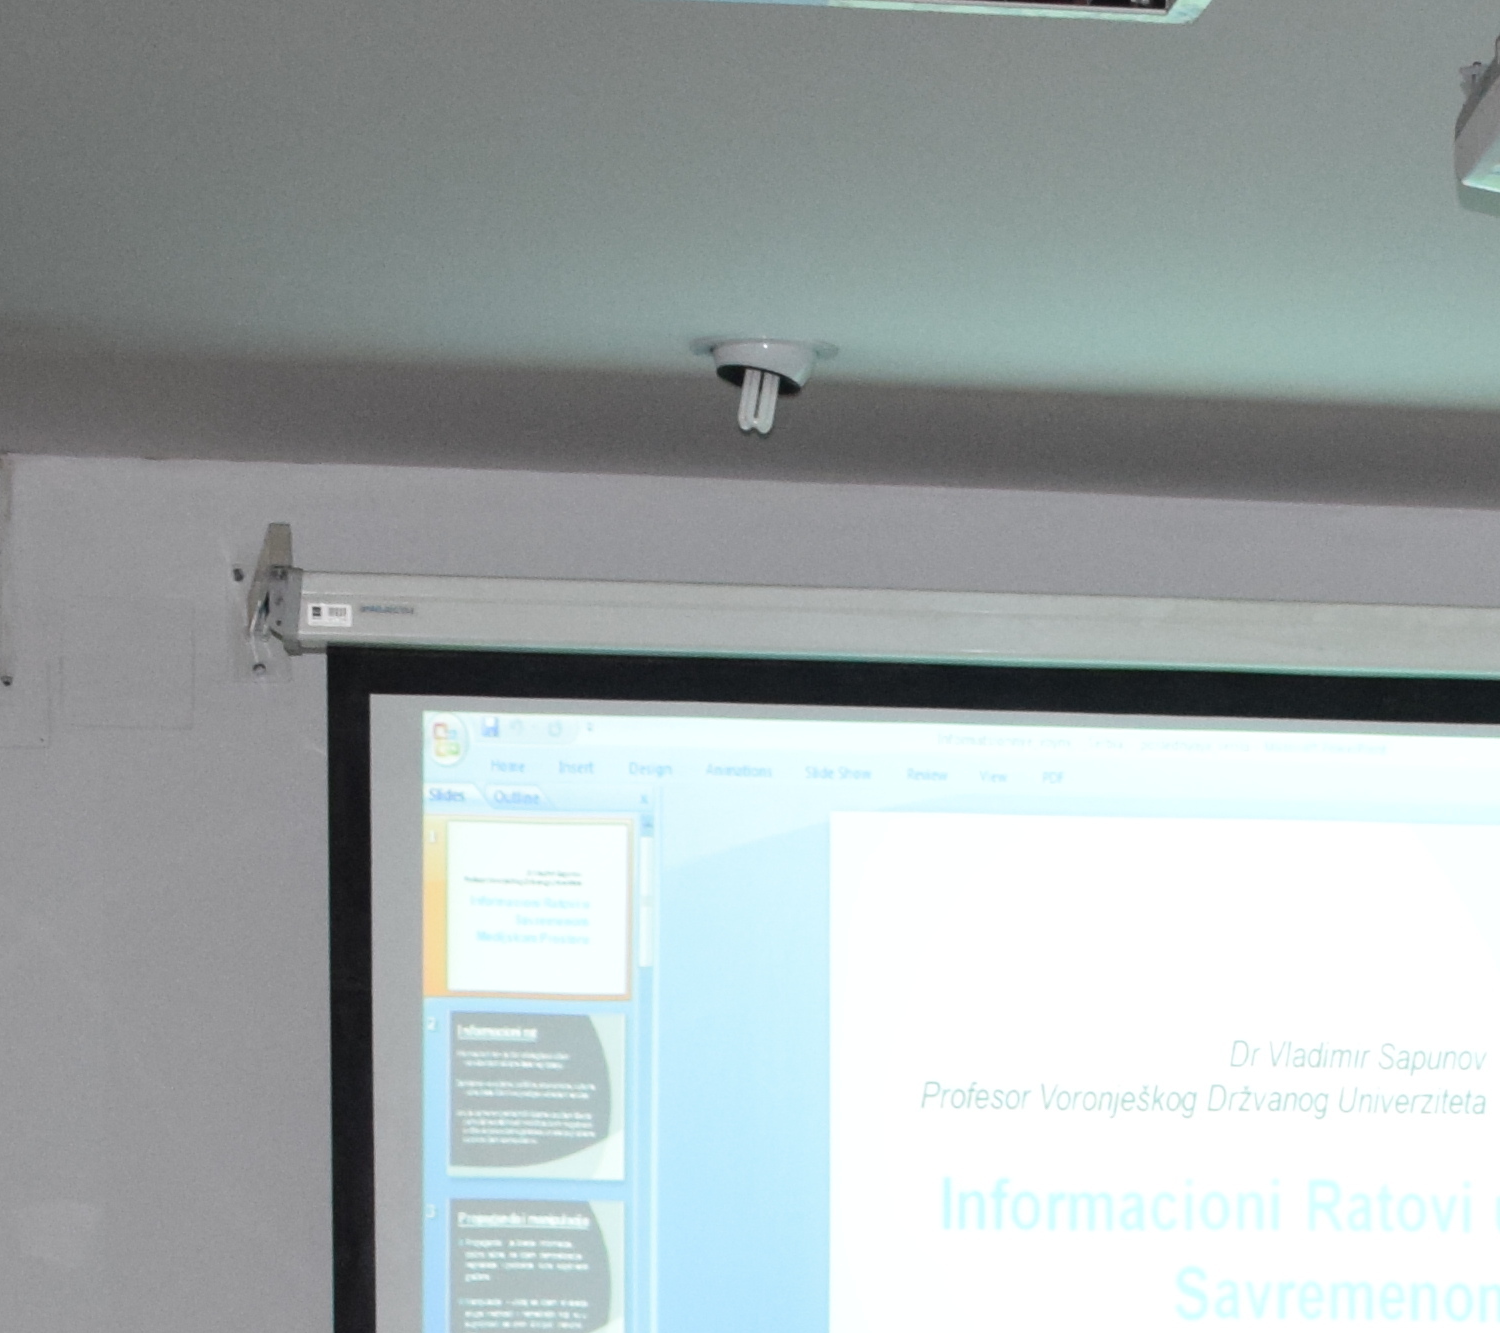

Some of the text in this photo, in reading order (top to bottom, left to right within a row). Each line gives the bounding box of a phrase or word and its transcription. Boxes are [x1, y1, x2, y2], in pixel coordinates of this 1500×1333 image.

[491, 759, 526, 774] Home
[558, 760, 594, 774] Insert
[629, 761, 673, 778] Design
[706, 763, 772, 778] Animations
[805, 764, 872, 780] Slide Show
[906, 767, 948, 782] Review
[978, 769, 1008, 784] View
[1042, 771, 1064, 785] PDF
[429, 787, 465, 803] Slides
[494, 789, 540, 805] Outline
[1228, 1039, 1487, 1077] Dr Vladimir Sapunov
[919, 1080, 1487, 1120] Profesor Voronješkog Držvanog Univerziteta
[941, 1175, 1282, 1232] Informacioni
[1306, 1178, 1472, 1234] Ratovi
